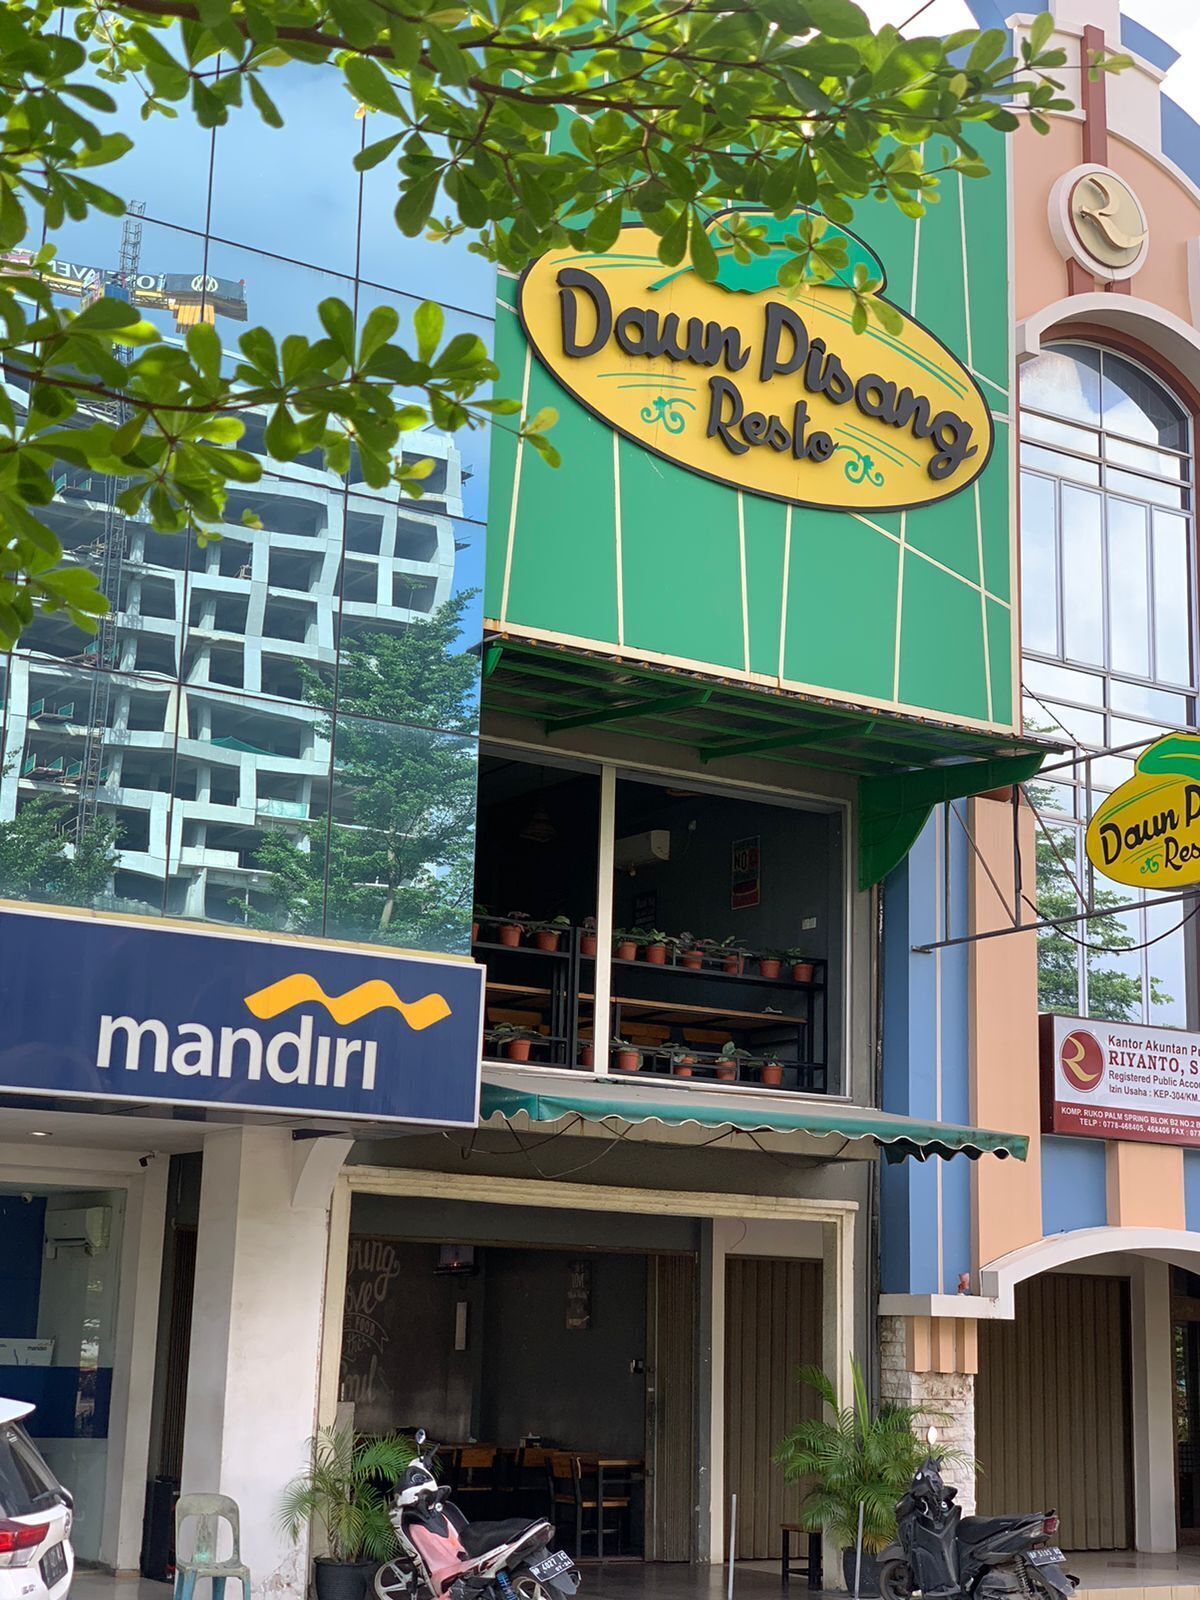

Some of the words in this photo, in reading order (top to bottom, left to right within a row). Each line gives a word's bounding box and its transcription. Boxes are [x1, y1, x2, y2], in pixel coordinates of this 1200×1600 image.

[555, 267, 751, 372] Daun
[760, 301, 978, 481] Pisang
[706, 376, 838, 463] Resto
[1099, 808, 1180, 866] Daun
[96, 1014, 378, 1090] mandiri
[1108, 1034, 1143, 1050] Kantor
[1145, 1040, 1188, 1055] Akuntan
[1108, 1050, 1185, 1077] RIYANTO,
[1108, 1070, 1151, 1083] Registered
[1153, 1075, 1178, 1087] Public
[1109, 1084, 1122, 1094] Izin
[1124, 1086, 1148, 1097] Usaha
[1061, 1107, 1082, 1117] KOMP.
[1083, 1109, 1103, 1118] RUKO
[1104, 1111, 1123, 1120] PALM
[1124, 1113, 1149, 1123] SPRING
[1150, 1116, 1169, 1125] BLOK
[1171, 1127, 1185, 1136] FAX
